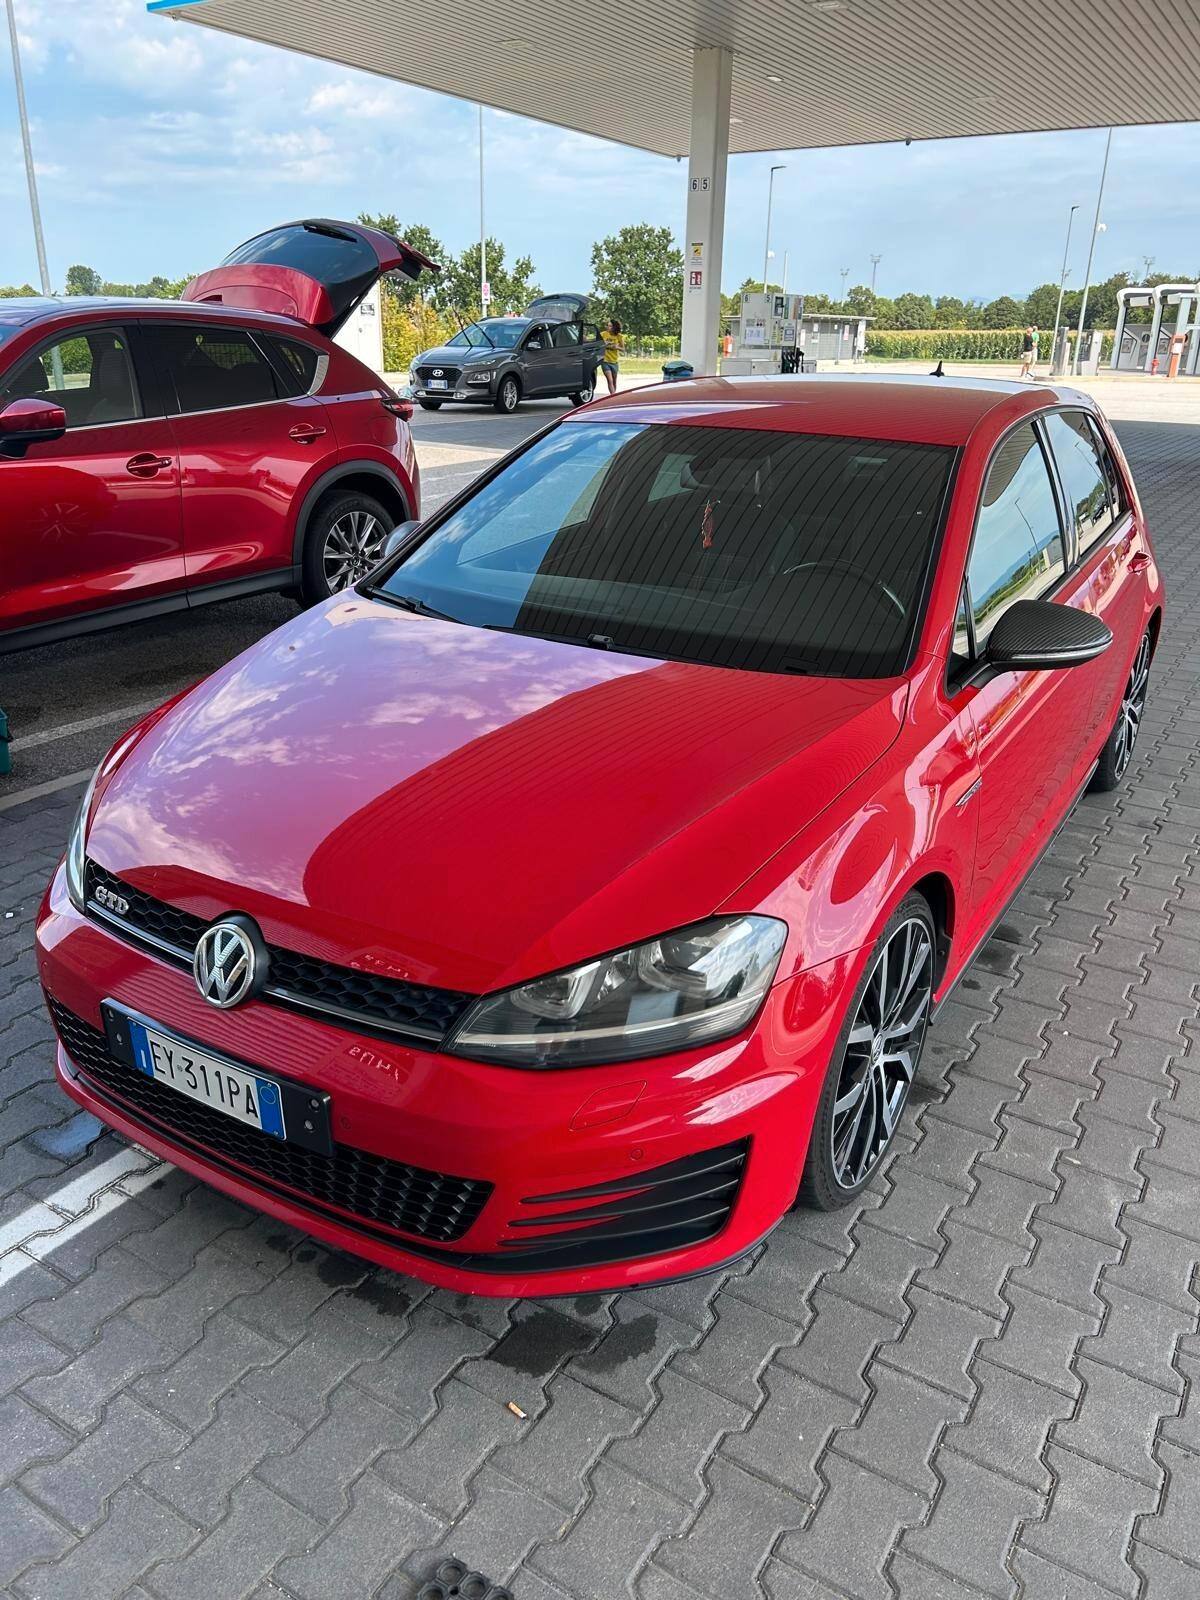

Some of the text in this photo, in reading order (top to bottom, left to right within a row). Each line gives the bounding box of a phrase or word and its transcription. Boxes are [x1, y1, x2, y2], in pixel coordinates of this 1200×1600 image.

[692, 179, 708, 190] 6 5
[95, 886, 129, 915] GTD
